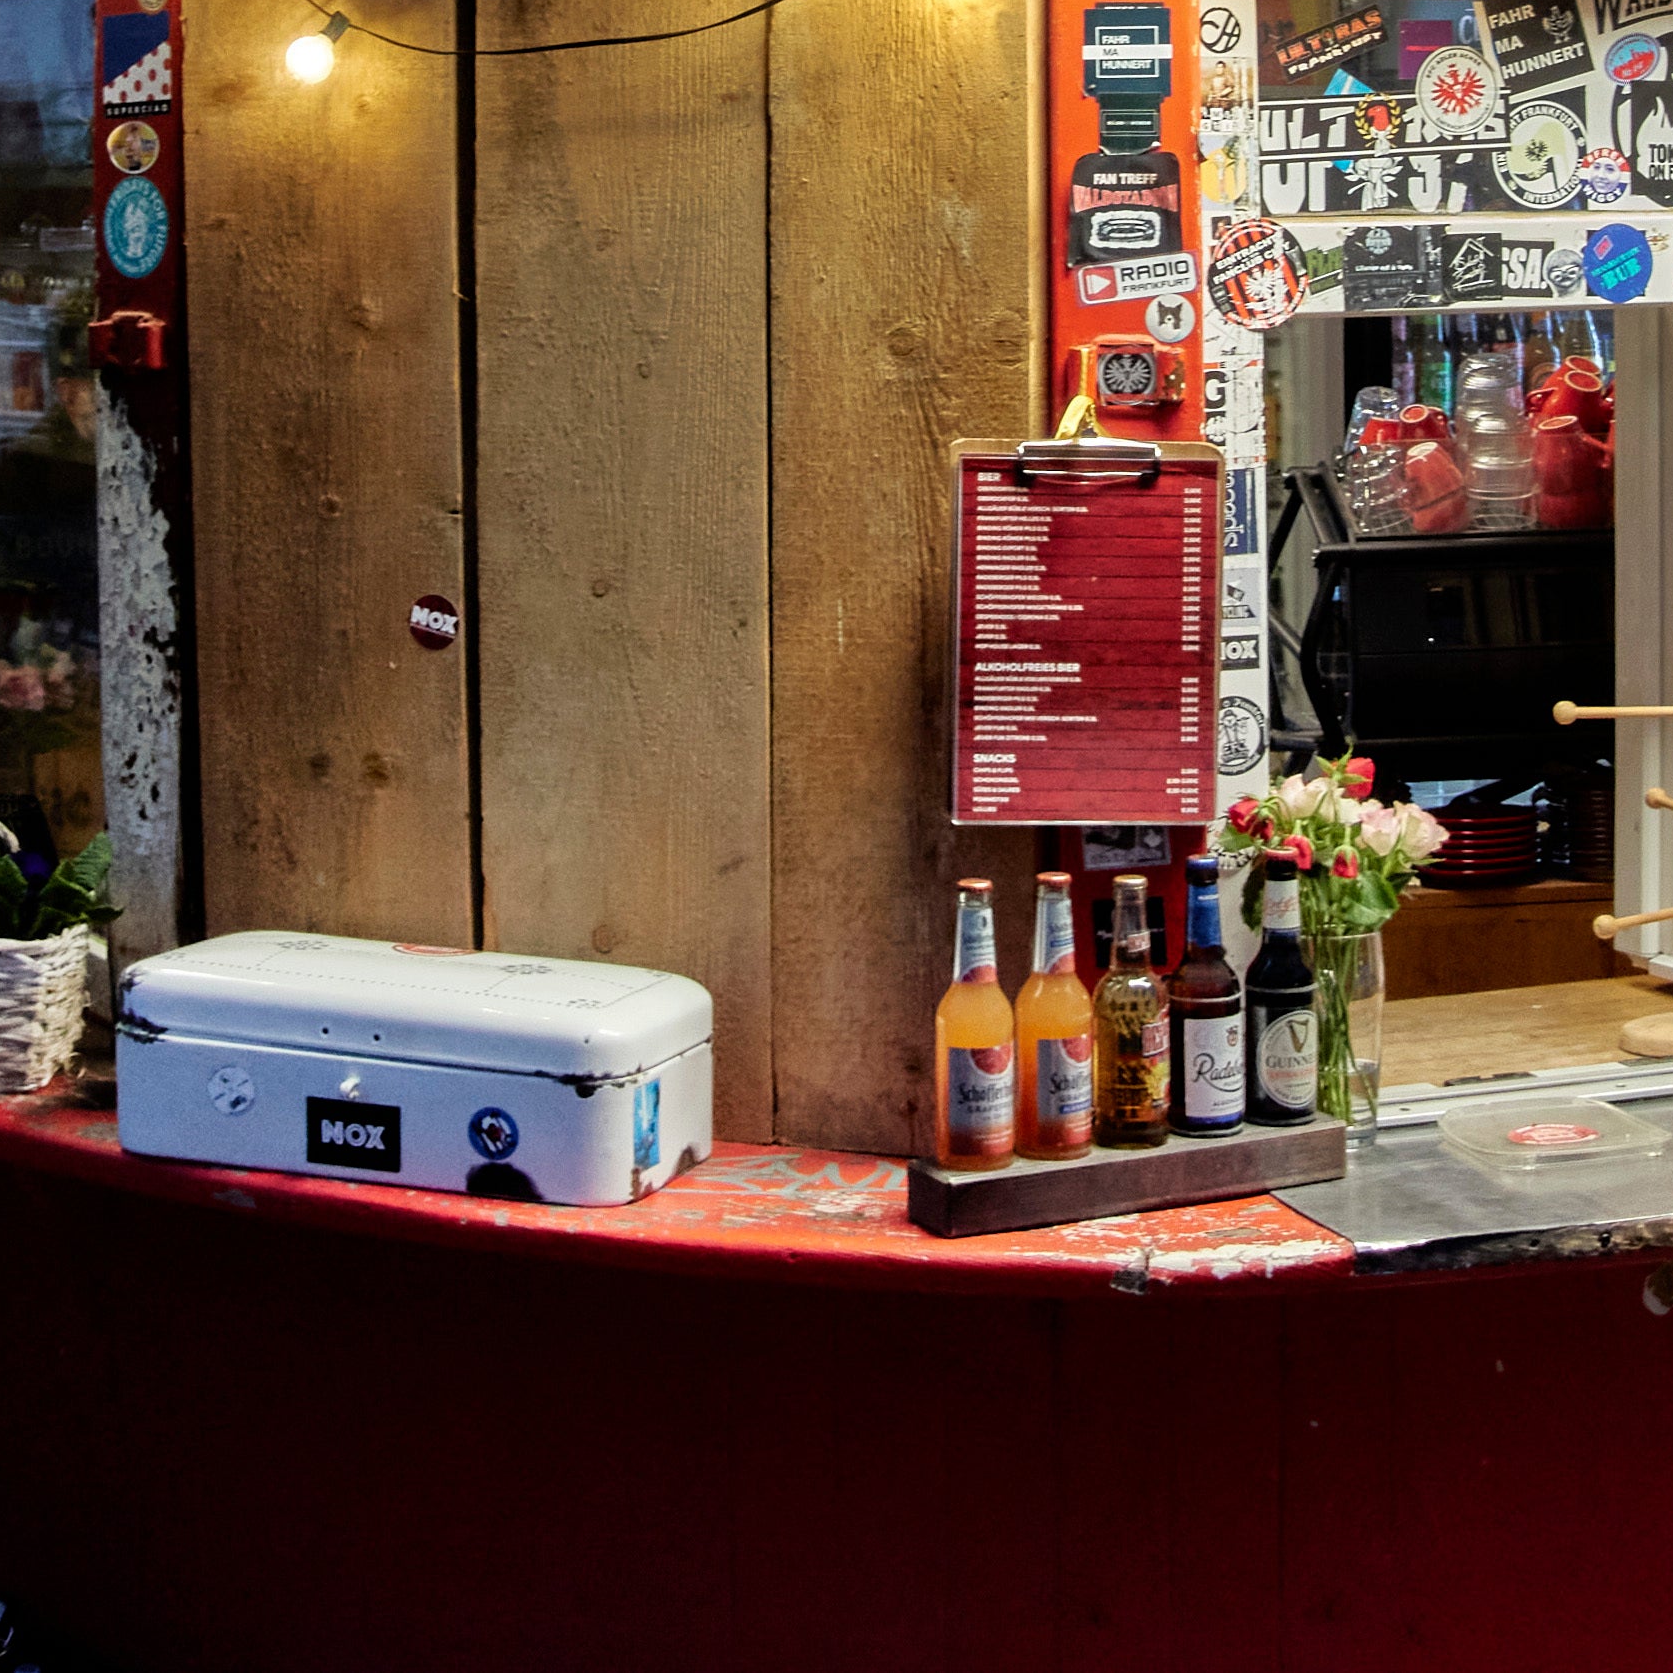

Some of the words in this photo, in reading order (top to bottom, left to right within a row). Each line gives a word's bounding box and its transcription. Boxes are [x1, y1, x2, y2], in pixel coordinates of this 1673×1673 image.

[1489, 4, 1536, 29] FAHR
[1101, 35, 1131, 45] FAHR
[1495, 38, 1524, 55] MA
[1102, 48, 1119, 57] MA
[1101, 59, 1153, 70] HUNNERT
[1501, 42, 1586, 80] HUNNERT
[1092, 174, 1118, 185] FAN
[1119, 173, 1158, 184] TREFF
[1120, 260, 1190, 282] RADIO
[1121, 278, 1190, 294] FRANKFURT
[977, 472, 1002, 483] BIER
[410, 604, 458, 635] NOX
[975, 662, 1056, 673] ALKOHOLFREIES
[1057, 663, 1081, 673] BIER
[973, 753, 1017, 764] SNACKS
[321, 1119, 386, 1151] NOX
